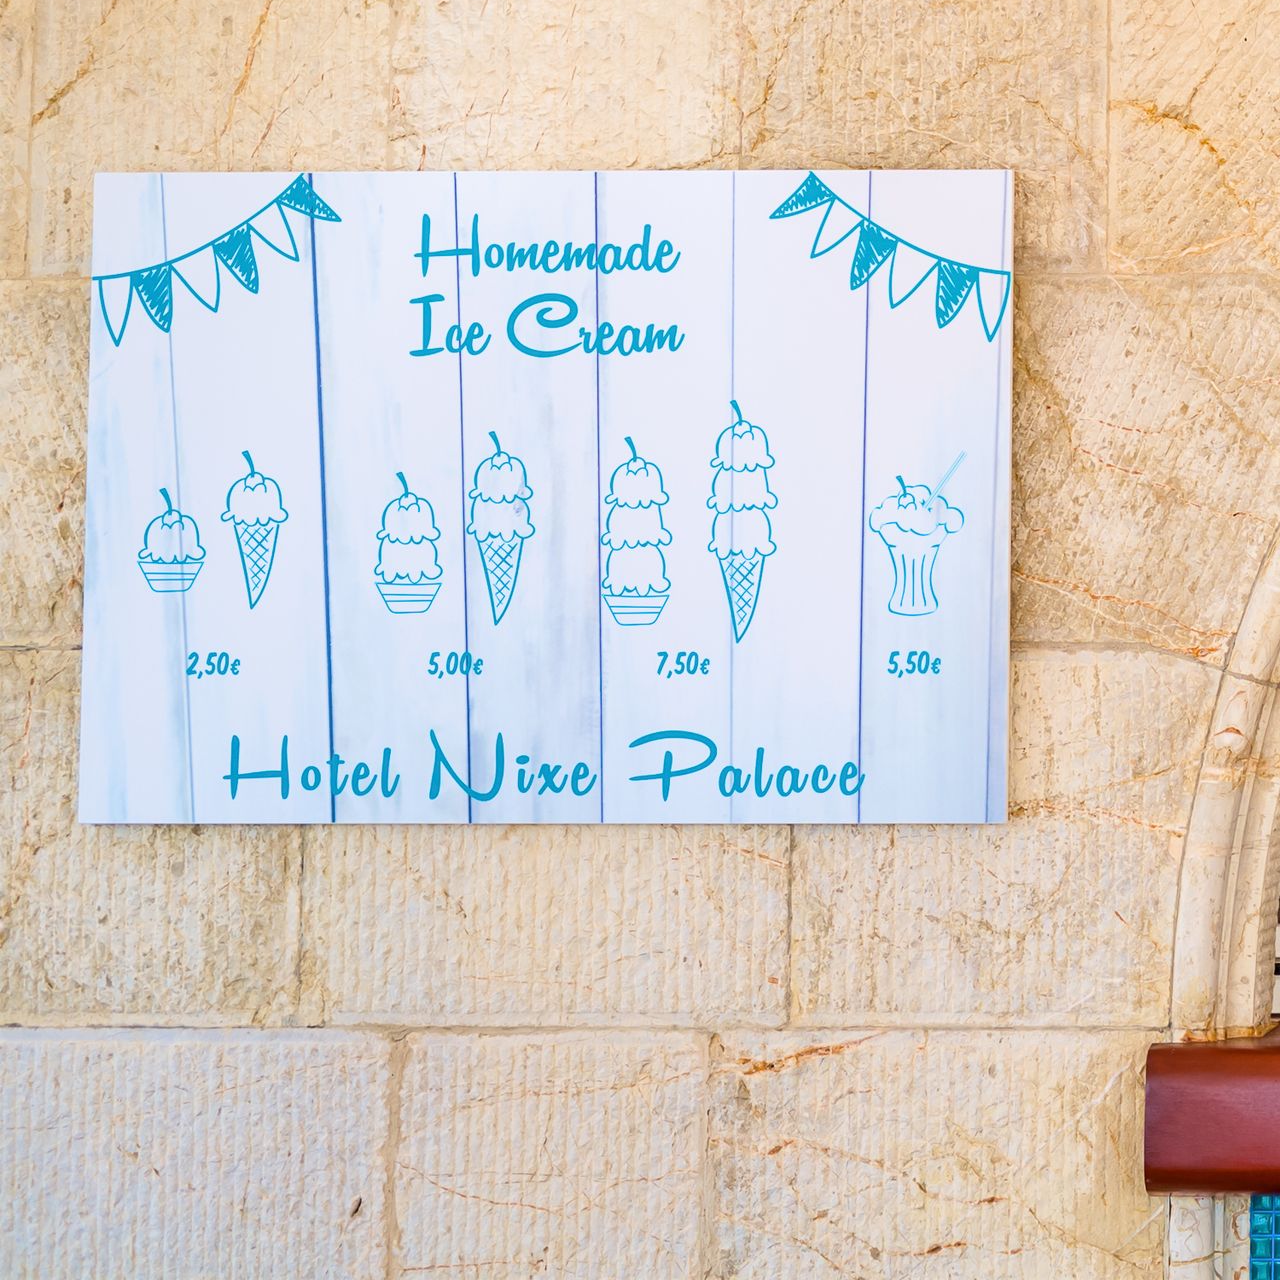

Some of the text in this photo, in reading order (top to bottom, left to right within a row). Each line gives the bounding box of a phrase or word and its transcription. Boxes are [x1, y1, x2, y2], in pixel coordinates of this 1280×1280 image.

[415, 212, 681, 277] Homemade
[408, 292, 685, 359] Ice Cream
[186, 651, 241, 679] 2,50€
[427, 651, 484, 679] 5,00€
[656, 651, 711, 679] 7,50€
[887, 650, 942, 678] 5,50€
[223, 729, 866, 804] Hotel Nixe Palace
